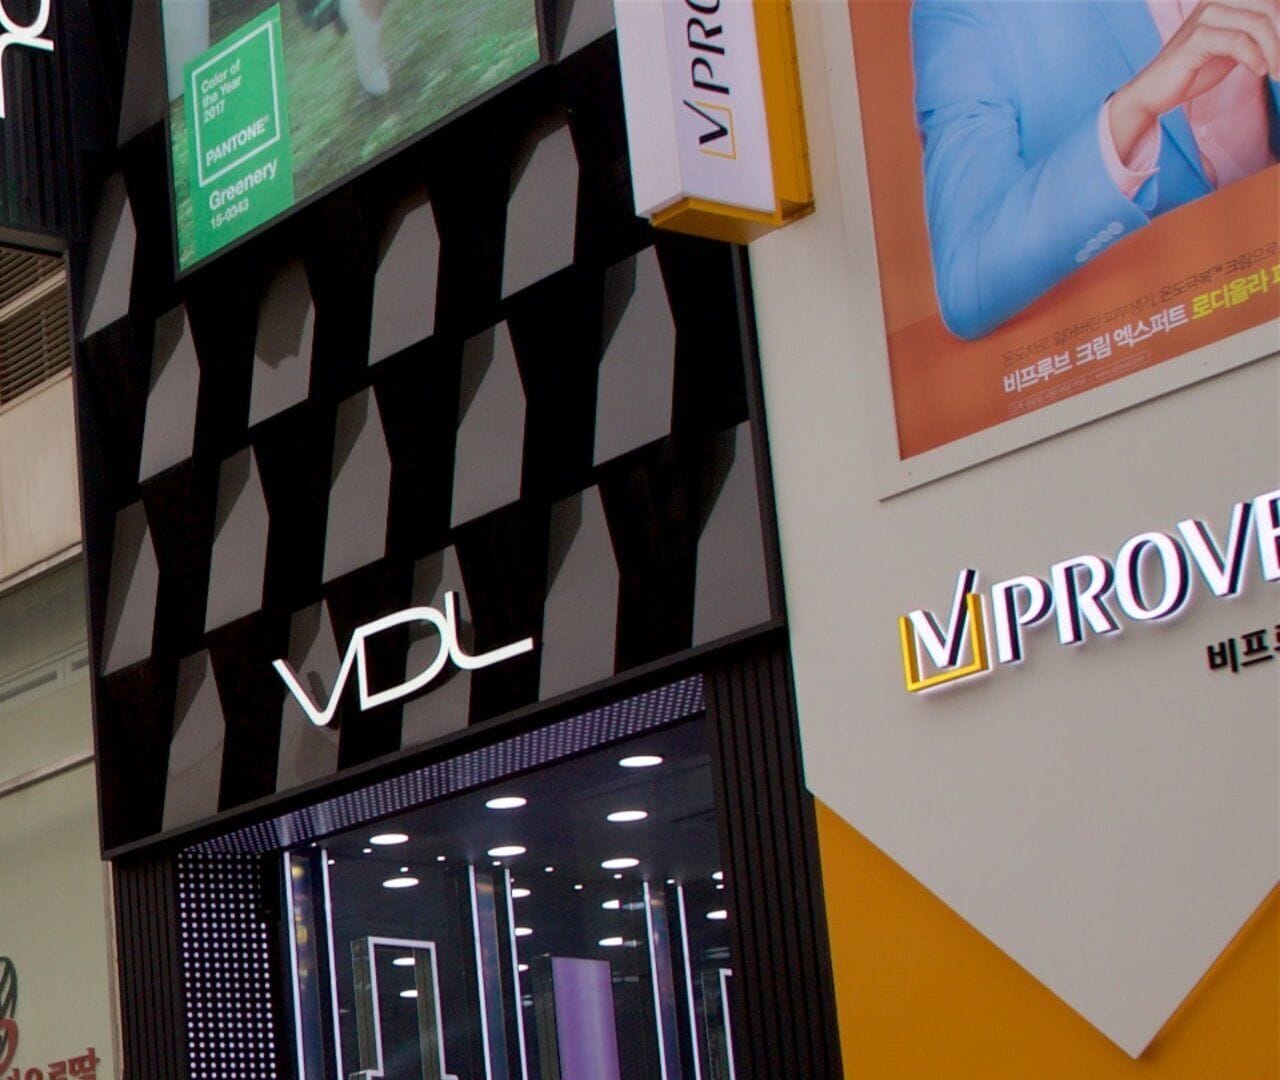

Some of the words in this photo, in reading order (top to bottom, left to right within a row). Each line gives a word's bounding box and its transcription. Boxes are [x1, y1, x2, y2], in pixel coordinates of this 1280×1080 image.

[201, 69, 227, 93] Color
[230, 58, 240, 75] of
[202, 92, 219, 108] the
[219, 75, 242, 97] Year
[203, 99, 226, 124] 2017
[209, 159, 278, 210] Greenery
[1004, 351, 1072, 393] 비프루브
[1075, 333, 1112, 366] 크림
[1113, 304, 1189, 348] 엑스퍼트
[272, 591, 534, 727] VDL
[1207, 624, 1280, 674] 비프
